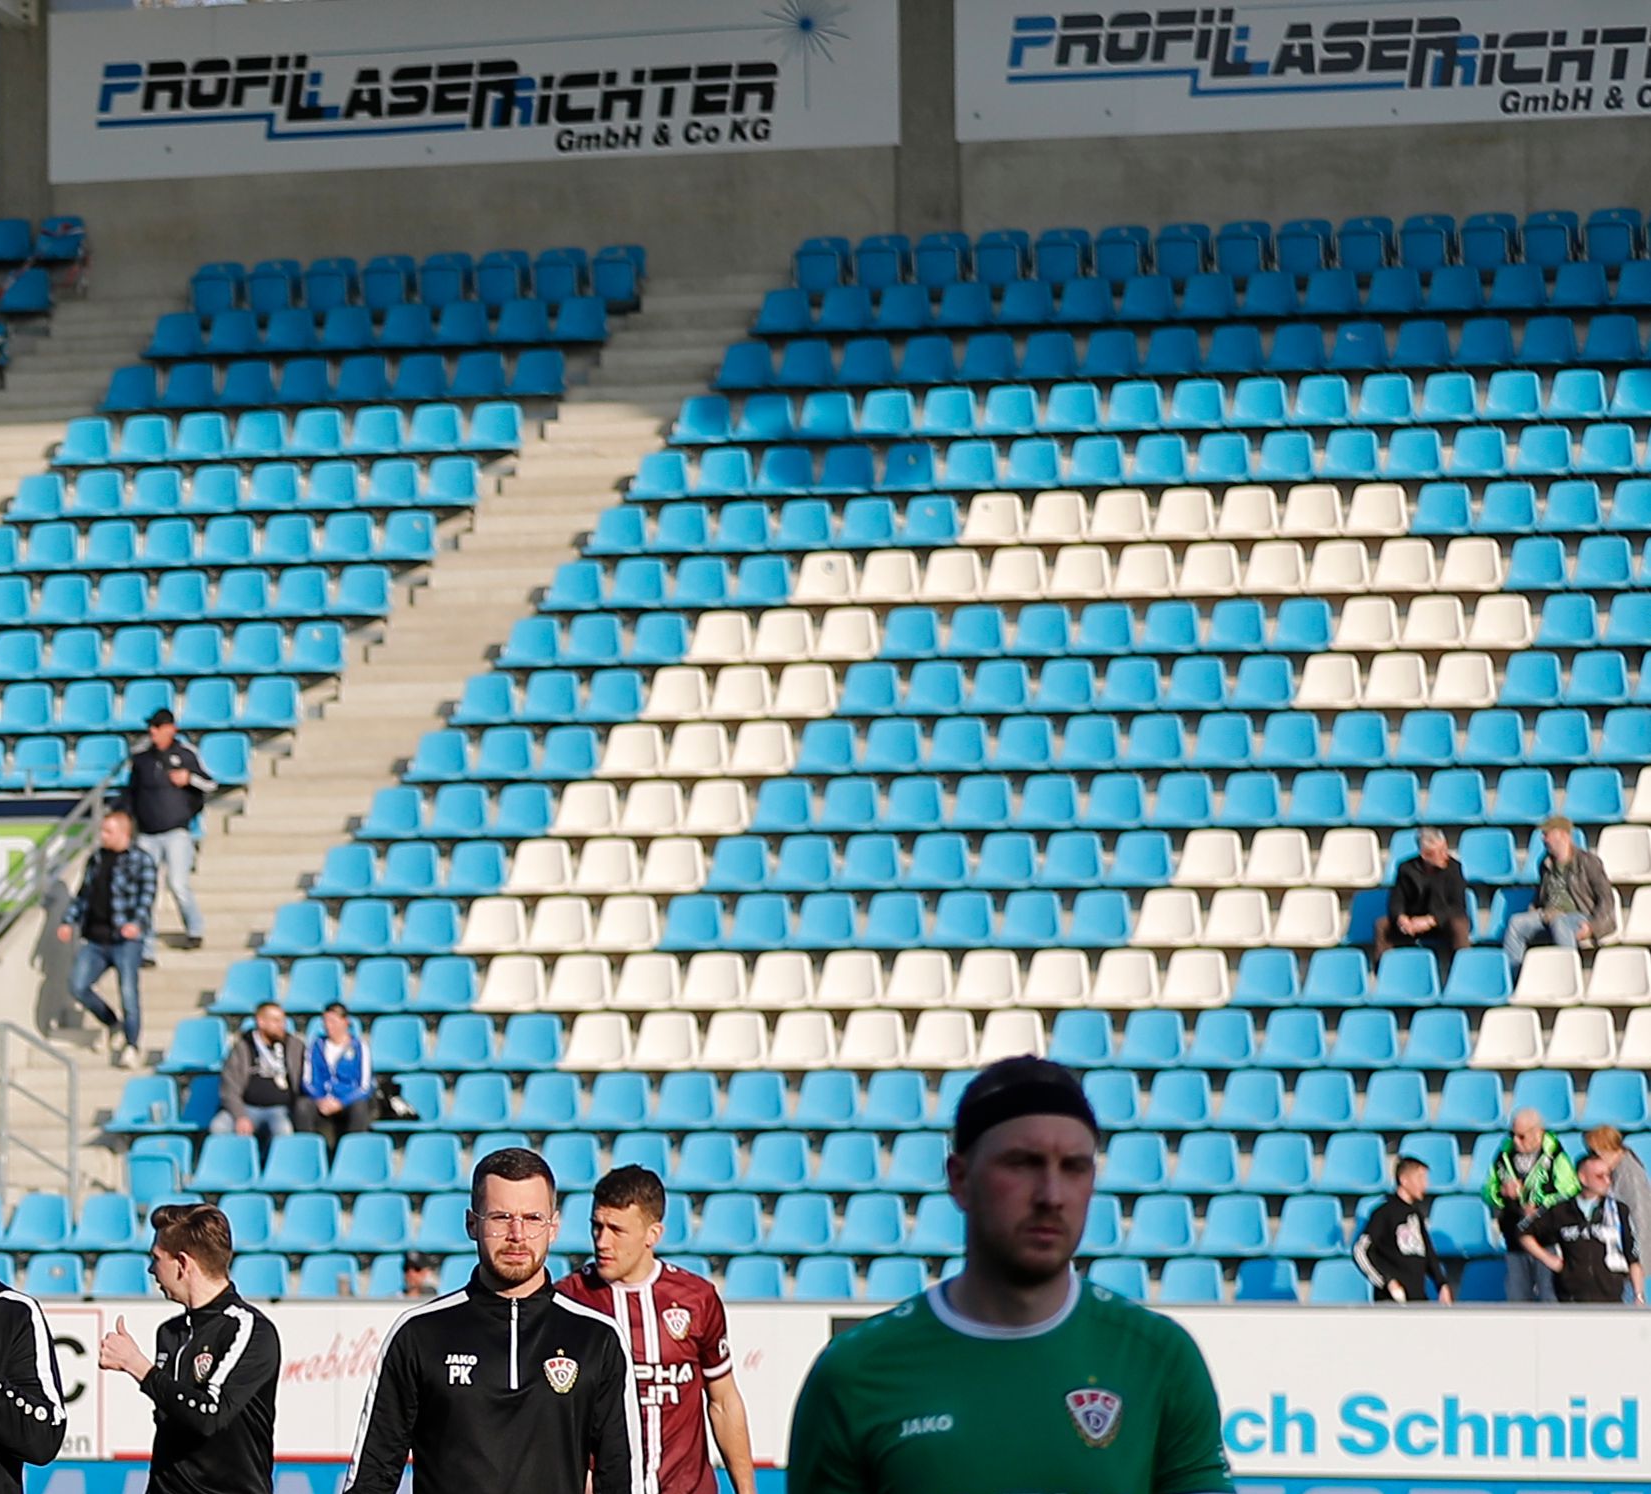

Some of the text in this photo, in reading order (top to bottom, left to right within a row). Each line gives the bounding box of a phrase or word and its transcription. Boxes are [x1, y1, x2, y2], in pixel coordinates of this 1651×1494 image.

[1500, 87, 1593, 114] GmbH
[1604, 86, 1626, 110] &
[555, 118, 773, 152] GmbH & Co KG
[445, 1354, 478, 1366] JAKO
[448, 1365, 473, 1385] PK
[1073, 1392, 1119, 1408] BFC
[899, 1413, 954, 1438] JAKO
[1338, 1392, 1640, 1460] Schmid
